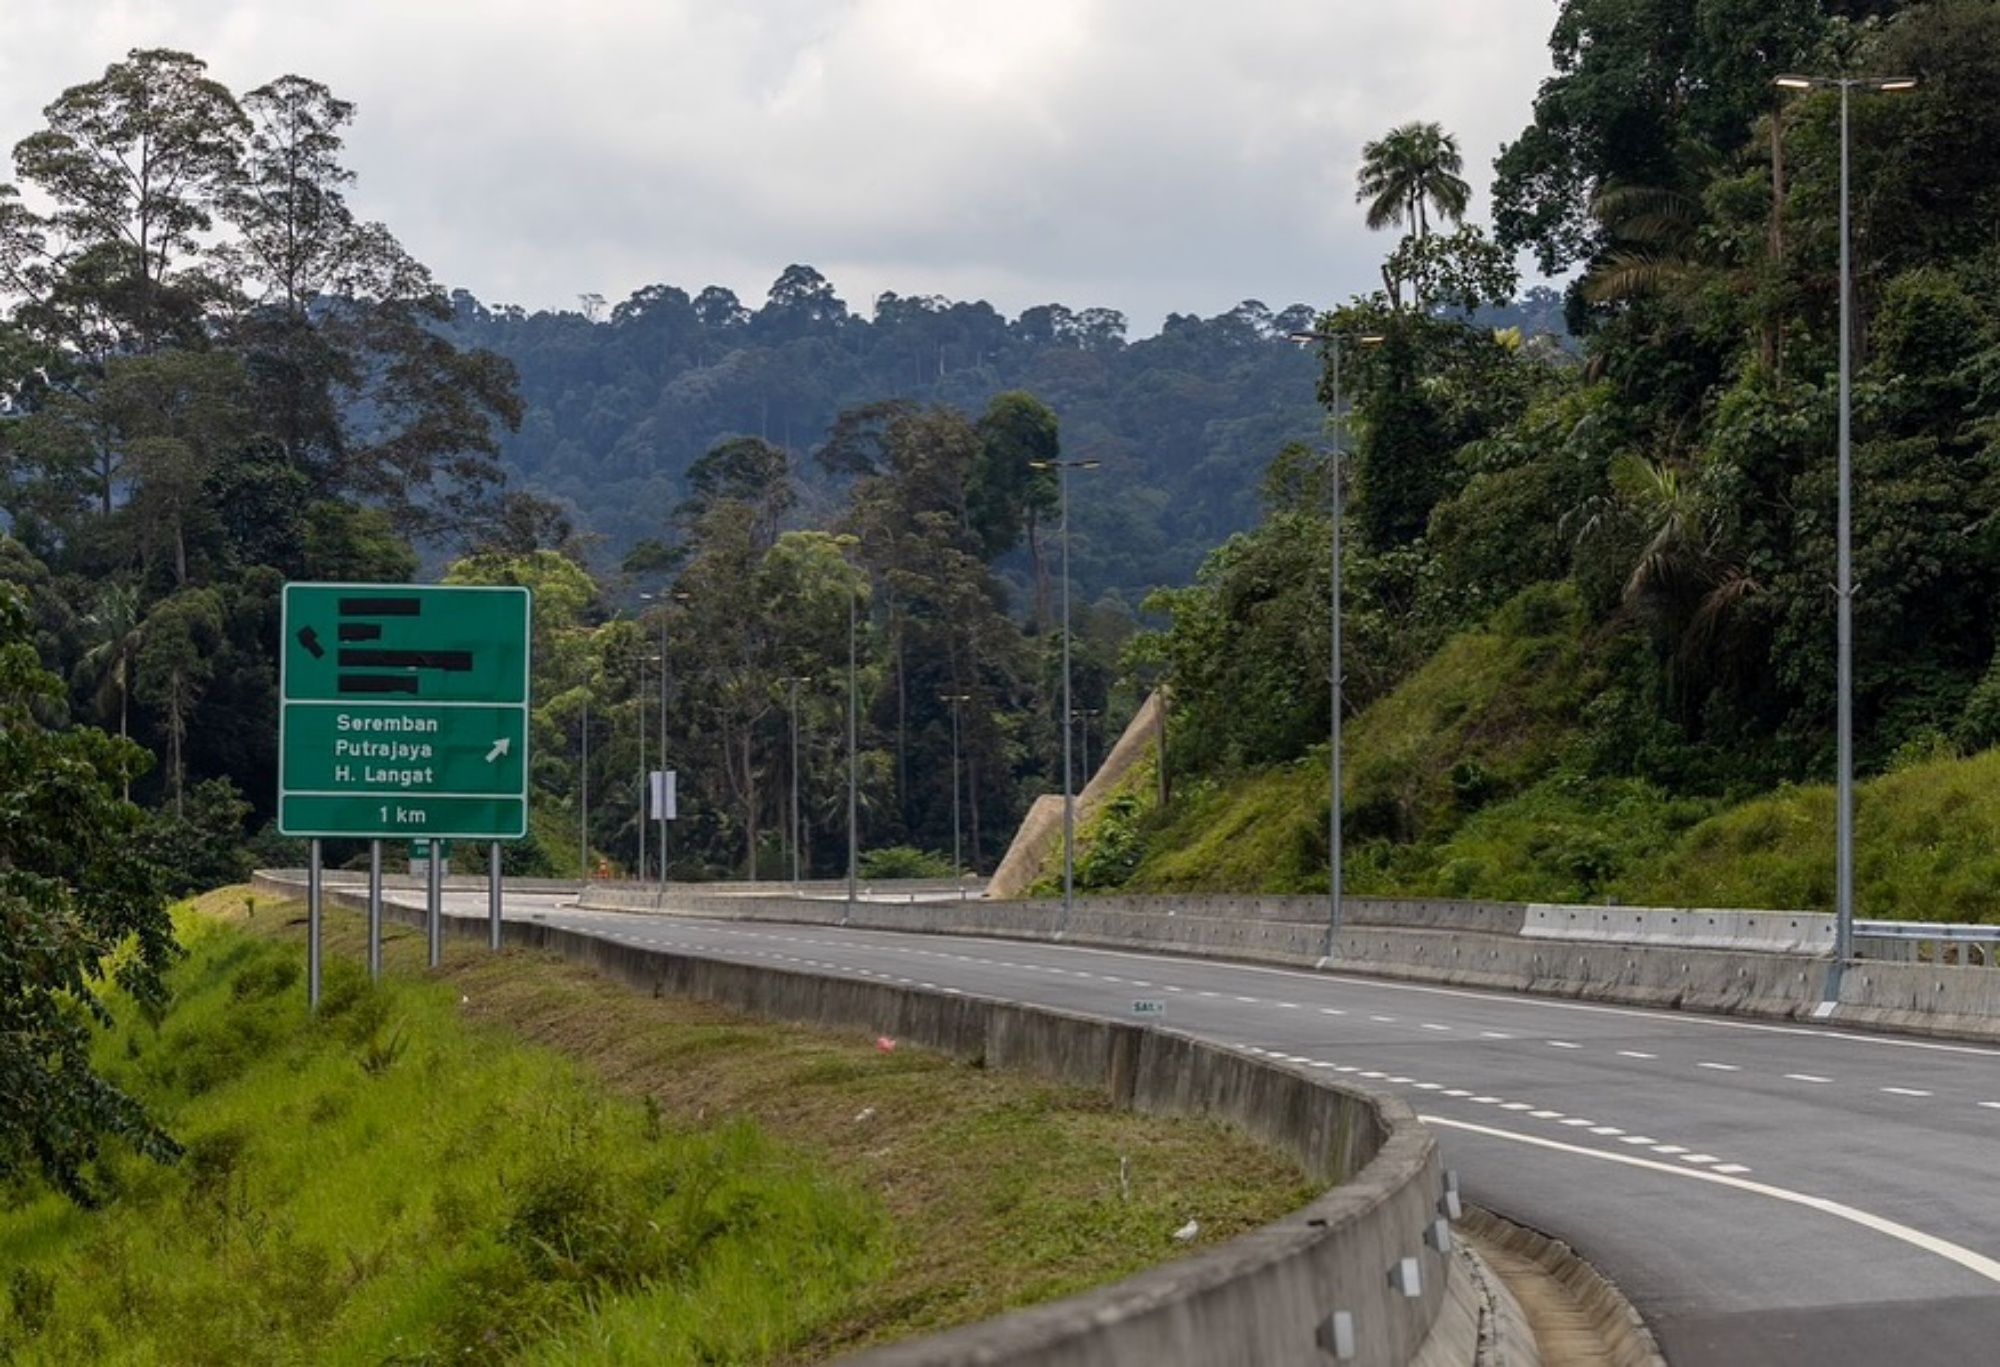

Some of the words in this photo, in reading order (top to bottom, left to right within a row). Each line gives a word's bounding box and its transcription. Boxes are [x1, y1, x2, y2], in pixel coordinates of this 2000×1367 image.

[336, 714, 438, 732] Seremban
[335, 740, 433, 760] Putrajaya
[335, 766, 356, 782] H.
[364, 766, 434, 786] Langat
[380, 807, 387, 822] 1
[396, 807, 427, 823] km
